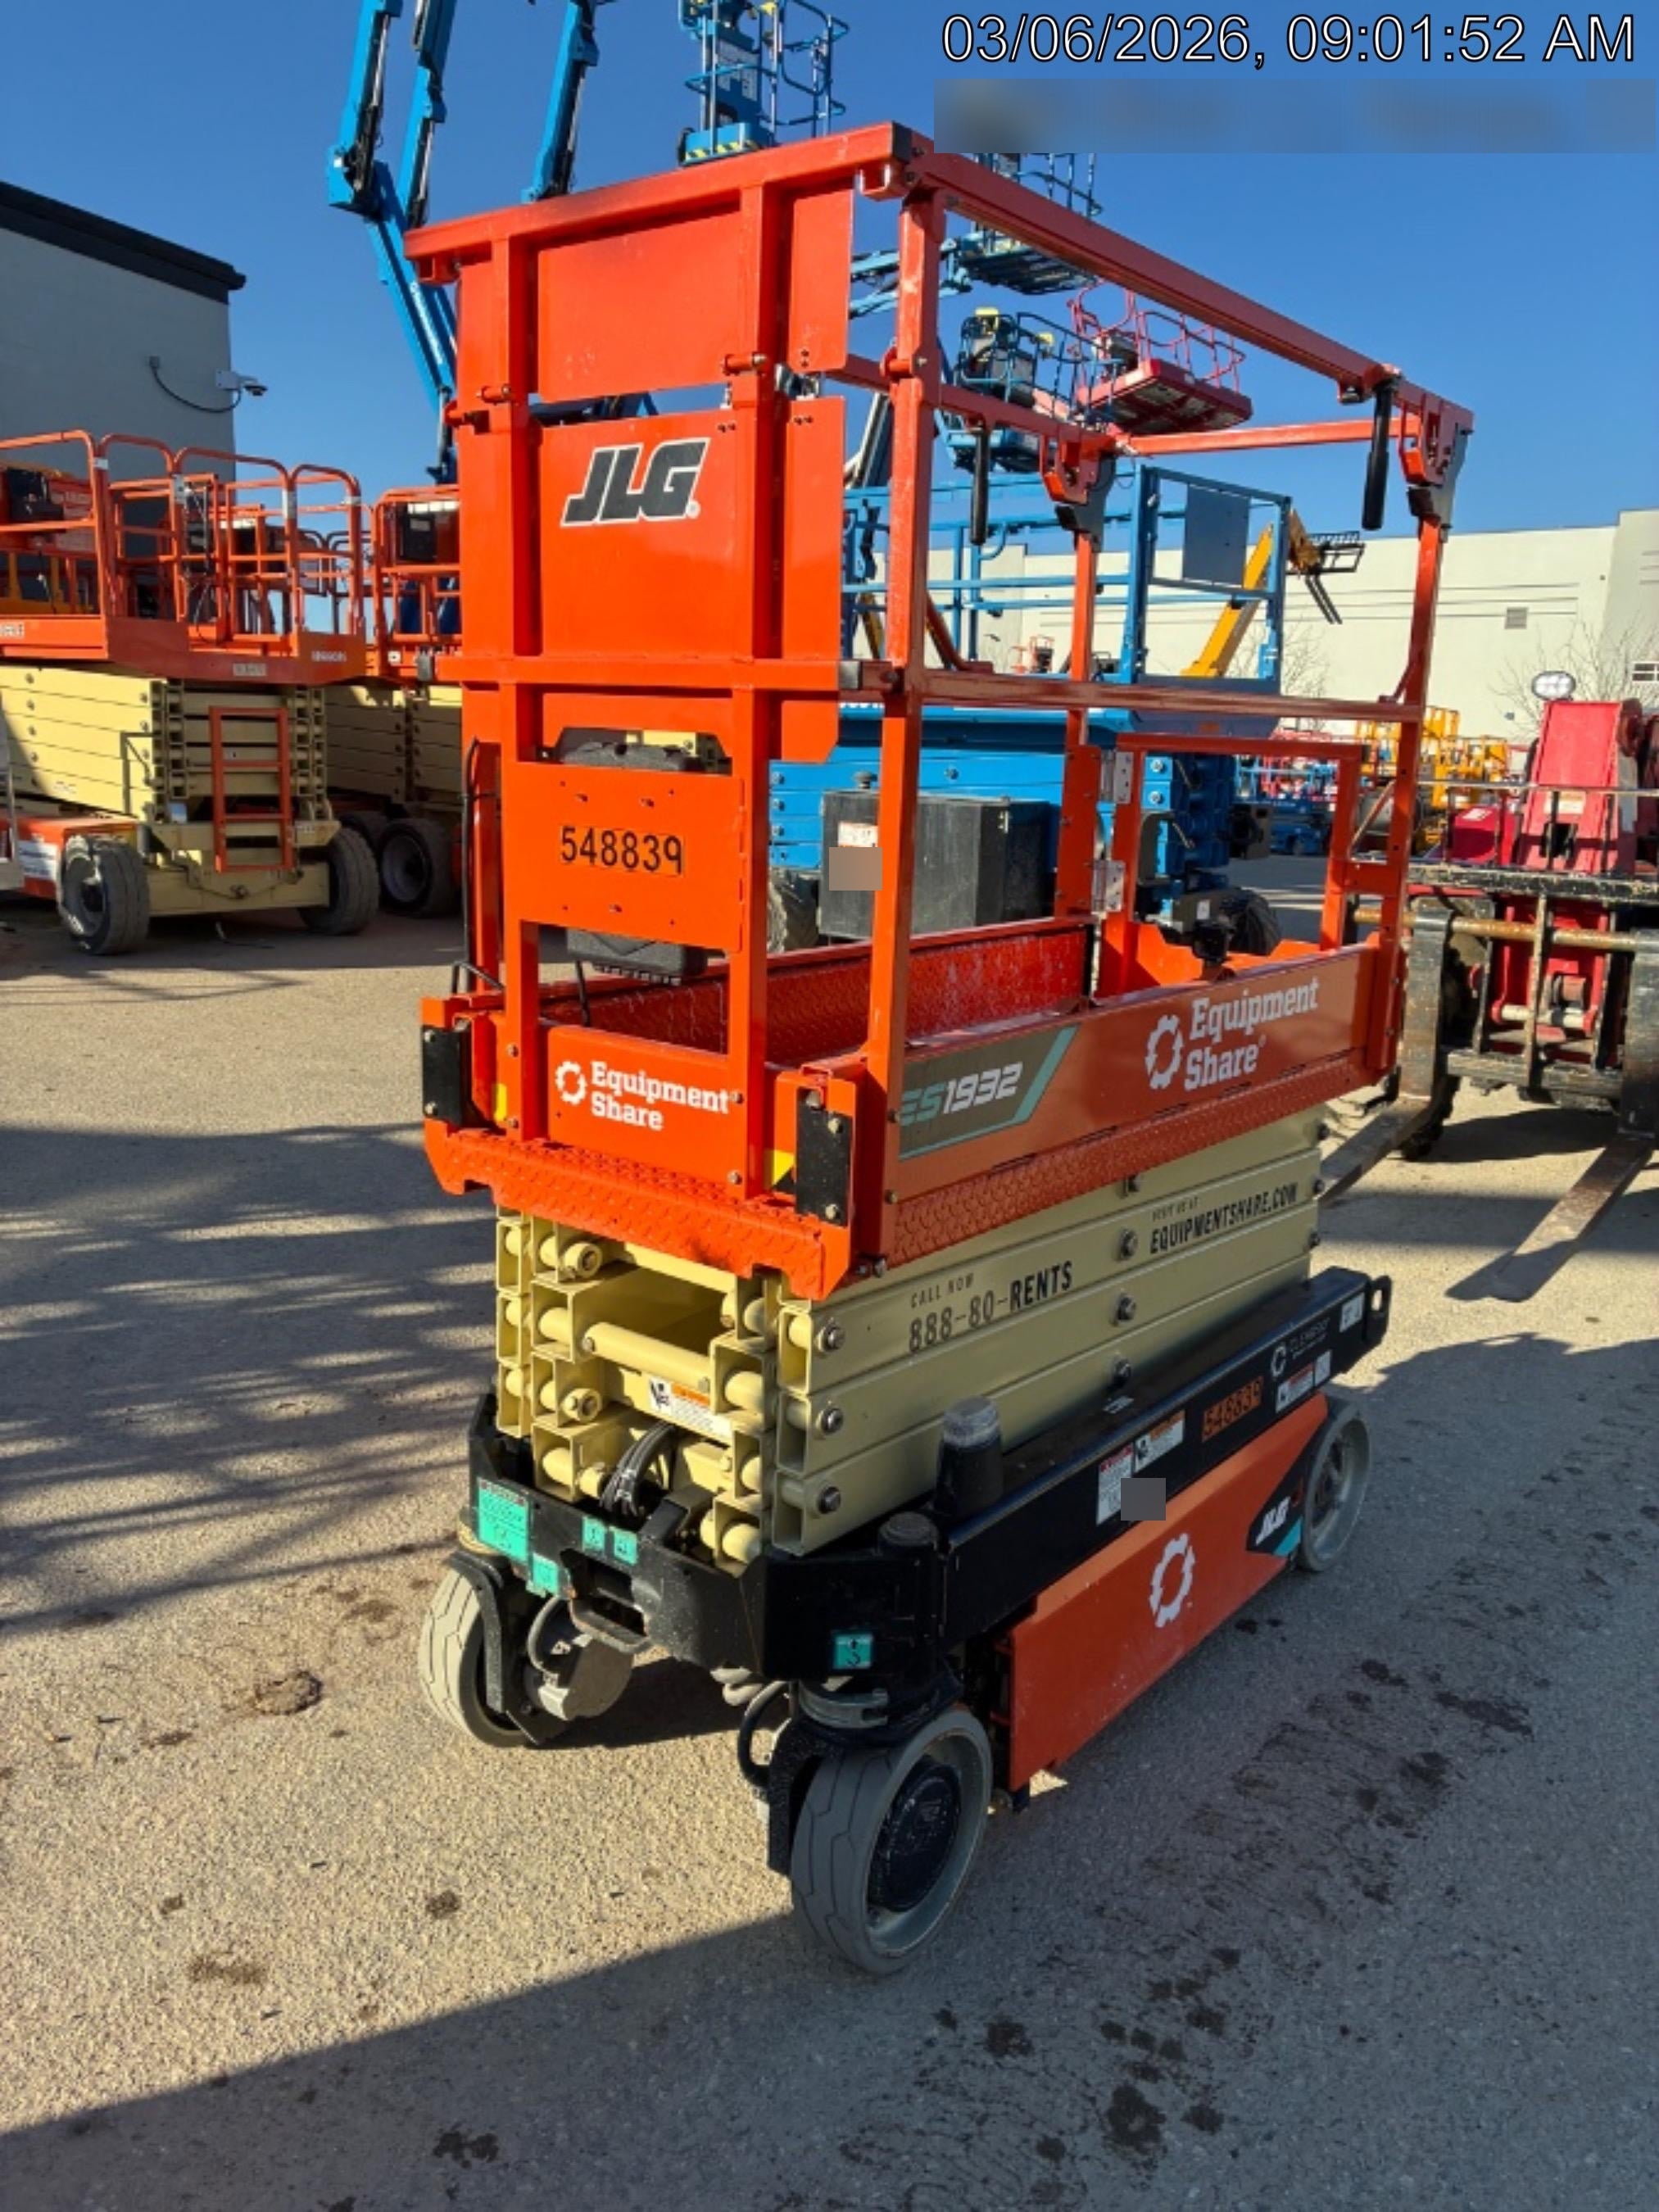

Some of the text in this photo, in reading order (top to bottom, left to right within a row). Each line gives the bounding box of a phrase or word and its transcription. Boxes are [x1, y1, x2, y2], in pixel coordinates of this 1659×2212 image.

[560, 437, 711, 528] JLG
[560, 826, 682, 875] 548839
[1190, 977, 1319, 1044] Equipment
[591, 1060, 729, 1114] Equipment
[1184, 1043, 1259, 1090] Share
[591, 1090, 664, 1131] Share
[1150, 1182, 1299, 1253] EQUIPMENTSHARE.COM
[909, 1260, 1072, 1353] 888-80-RENTS
[910, 1272, 974, 1308] CALL NOW
